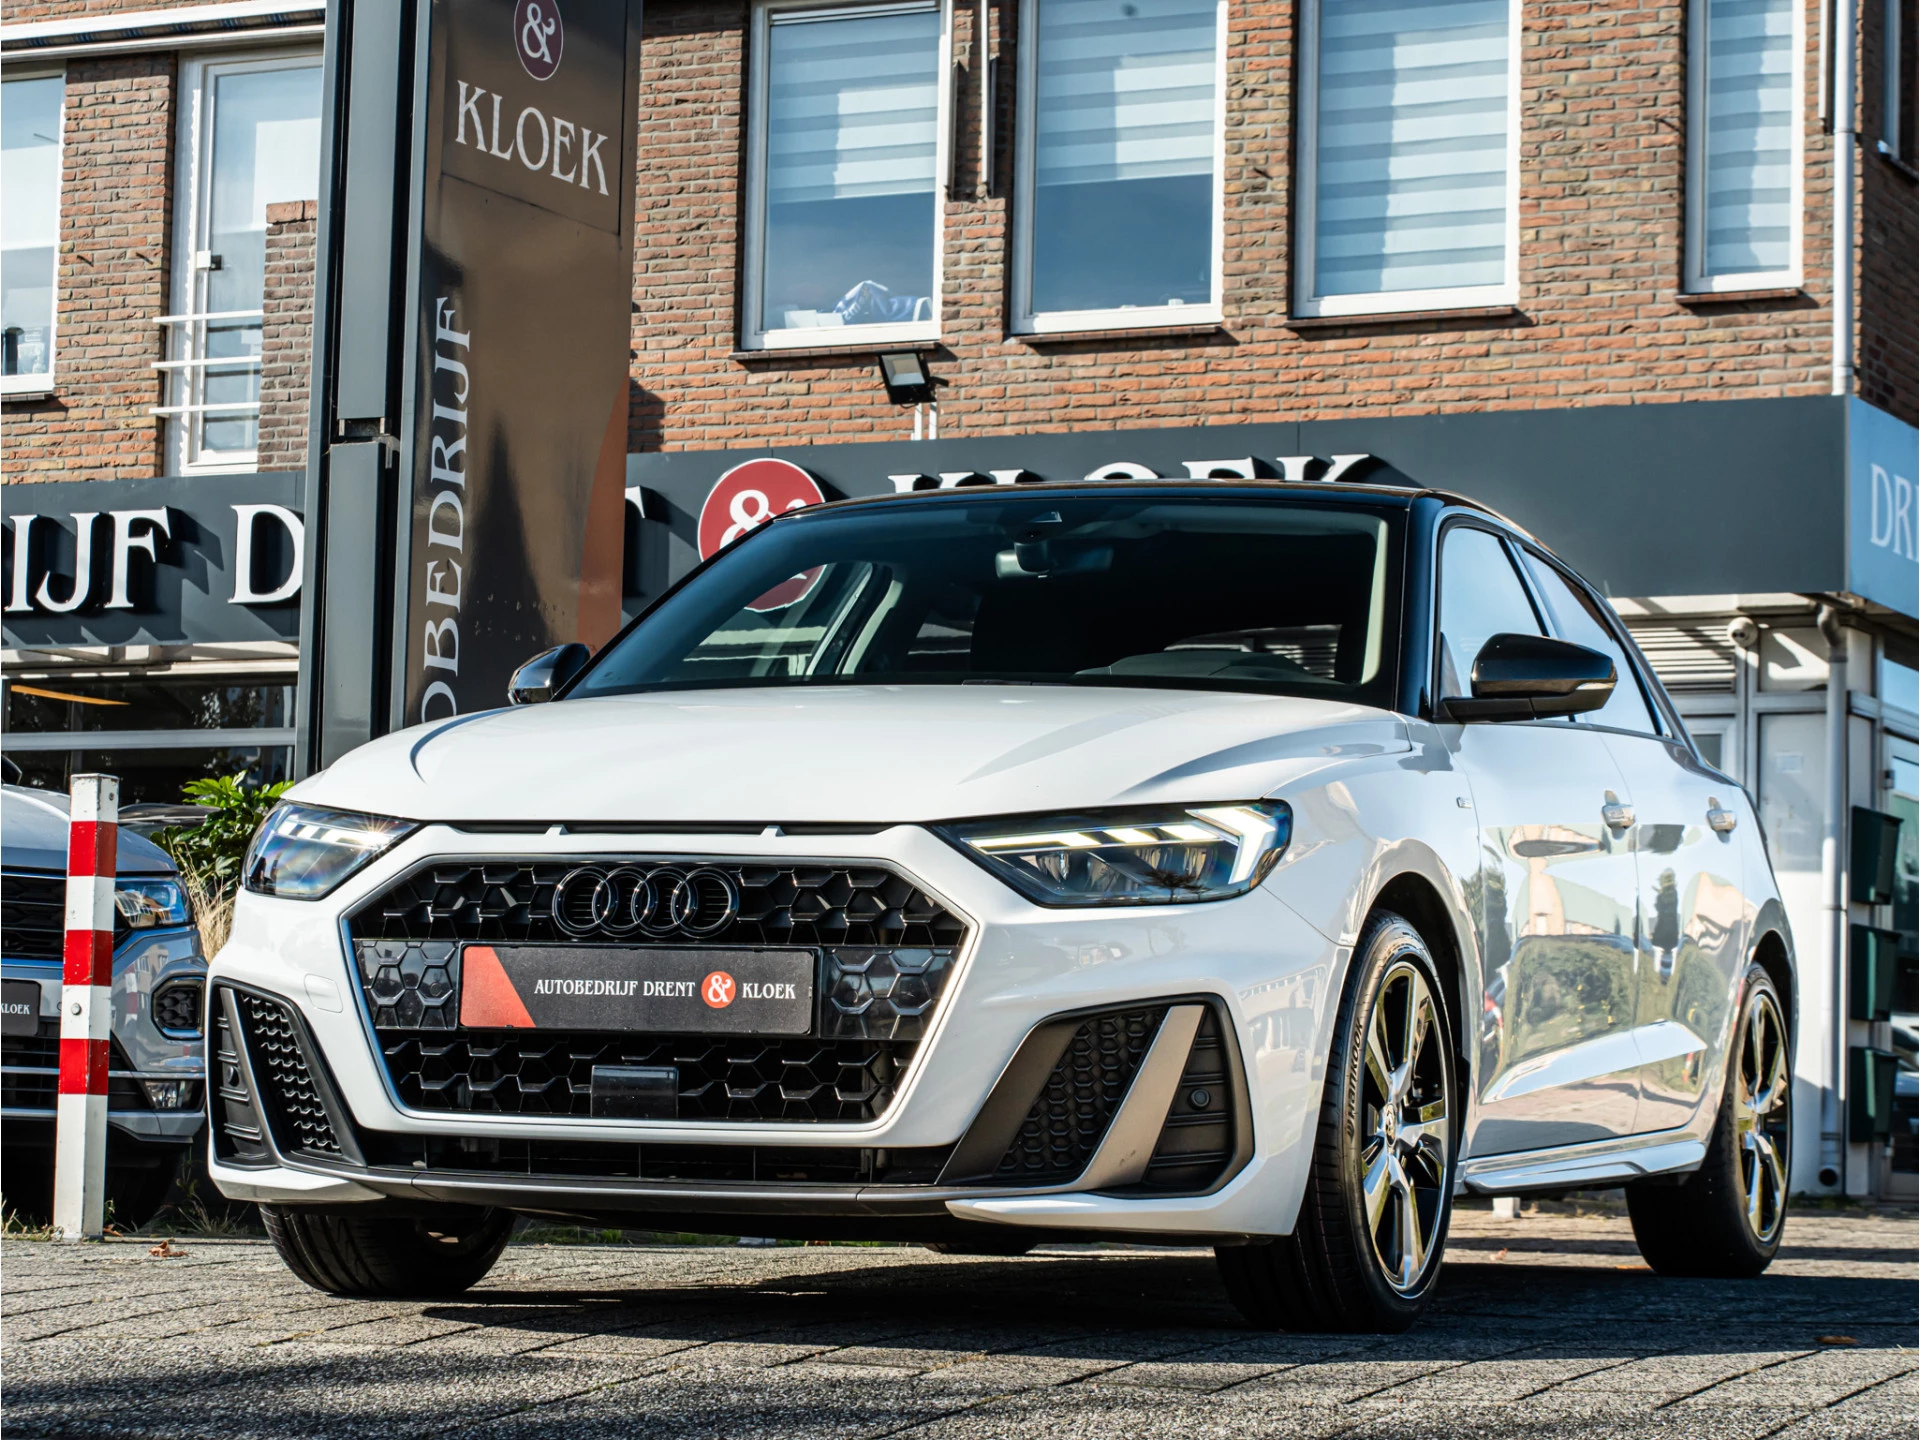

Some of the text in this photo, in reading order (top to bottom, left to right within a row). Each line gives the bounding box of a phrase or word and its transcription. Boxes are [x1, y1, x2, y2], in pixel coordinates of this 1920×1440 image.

[522, 2, 556, 64] &
[455, 79, 609, 197] KLOEK
[5, 505, 172, 613] IJF
[228, 503, 305, 604] D
[1870, 462, 1919, 562] DR
[534, 974, 796, 1003] AUTOBEDRIJF DRENT & KLOEK
